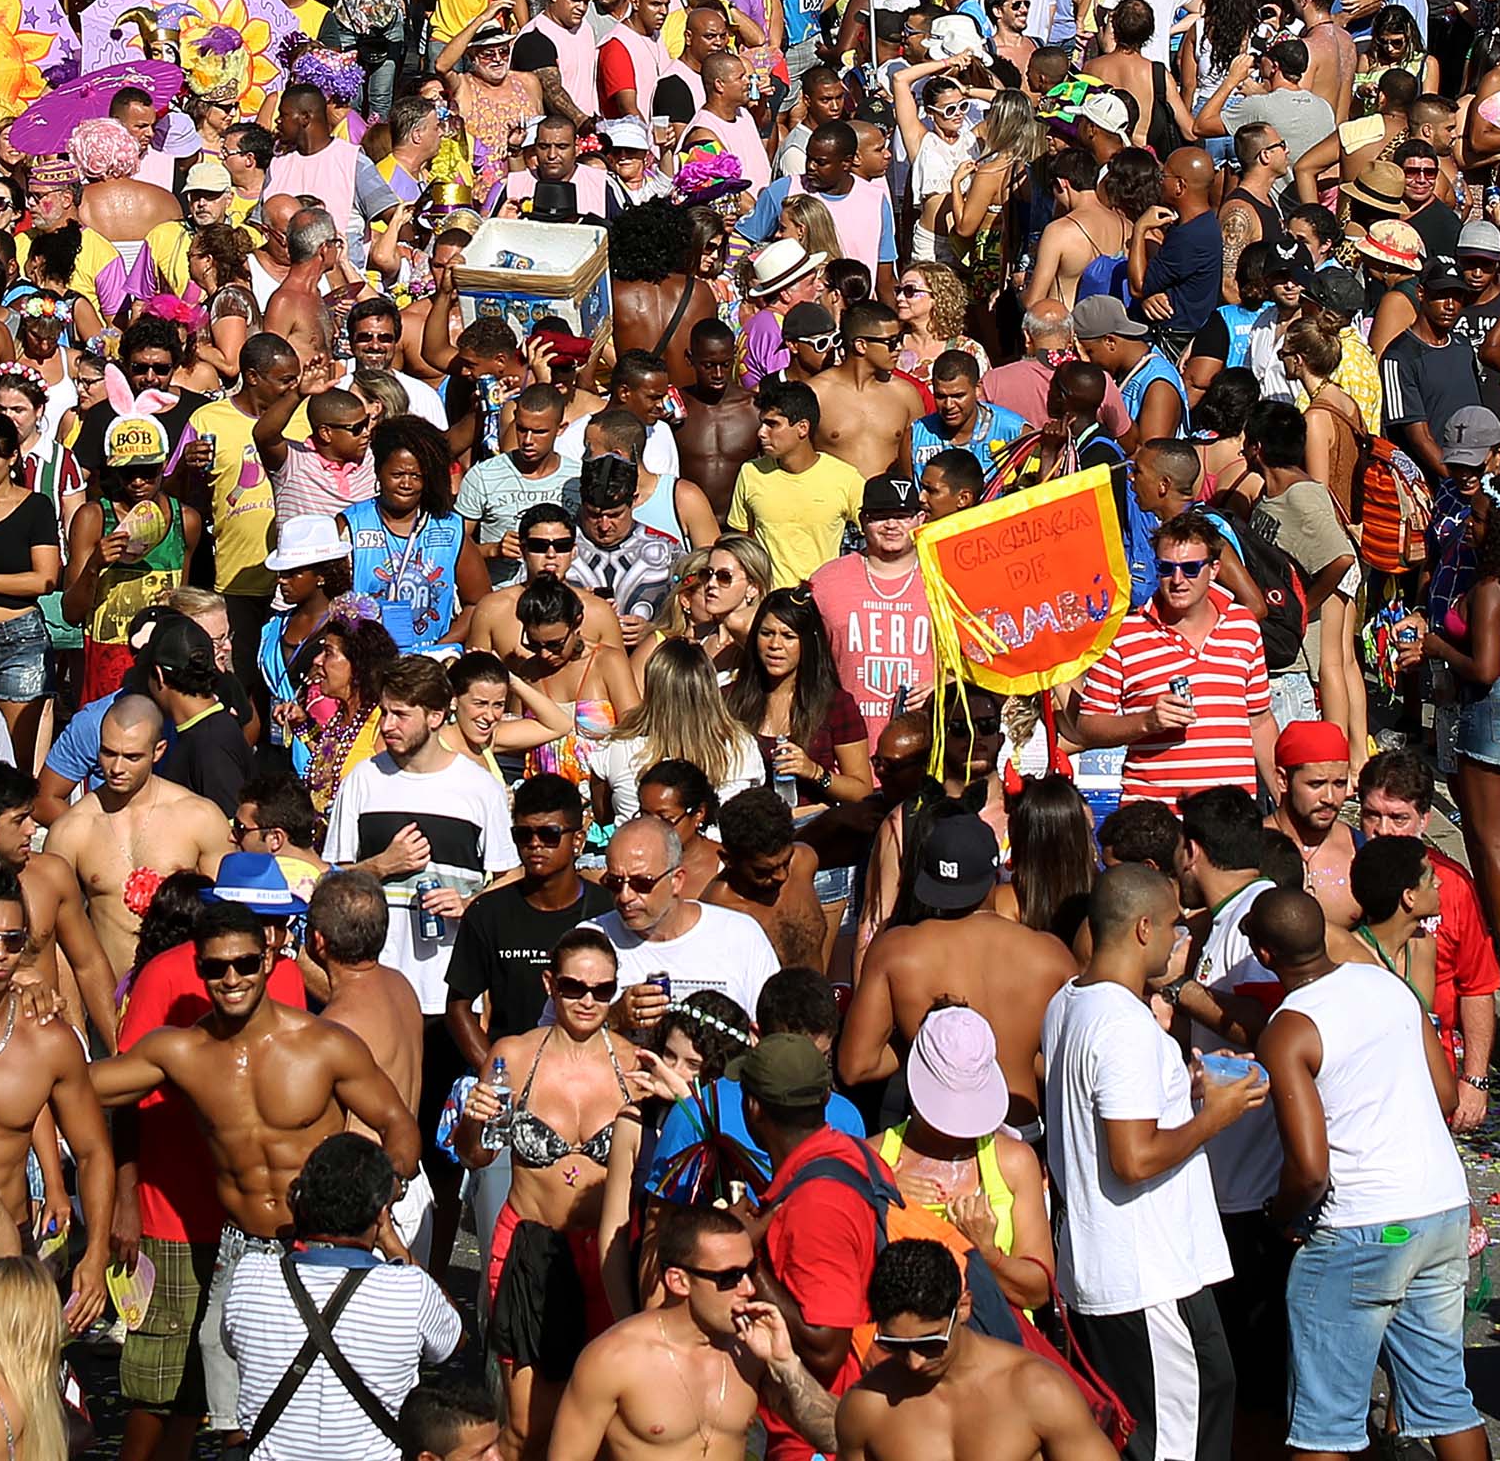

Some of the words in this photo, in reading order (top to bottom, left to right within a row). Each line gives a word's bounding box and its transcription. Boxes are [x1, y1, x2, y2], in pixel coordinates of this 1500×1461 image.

[116, 429, 152, 447] BOB
[1004, 555, 1051, 591] DE
[847, 611, 930, 656] AERO
[871, 660, 908, 687] NYC
[859, 701, 889, 717] SINCE
[498, 949, 539, 959] TOMMY
